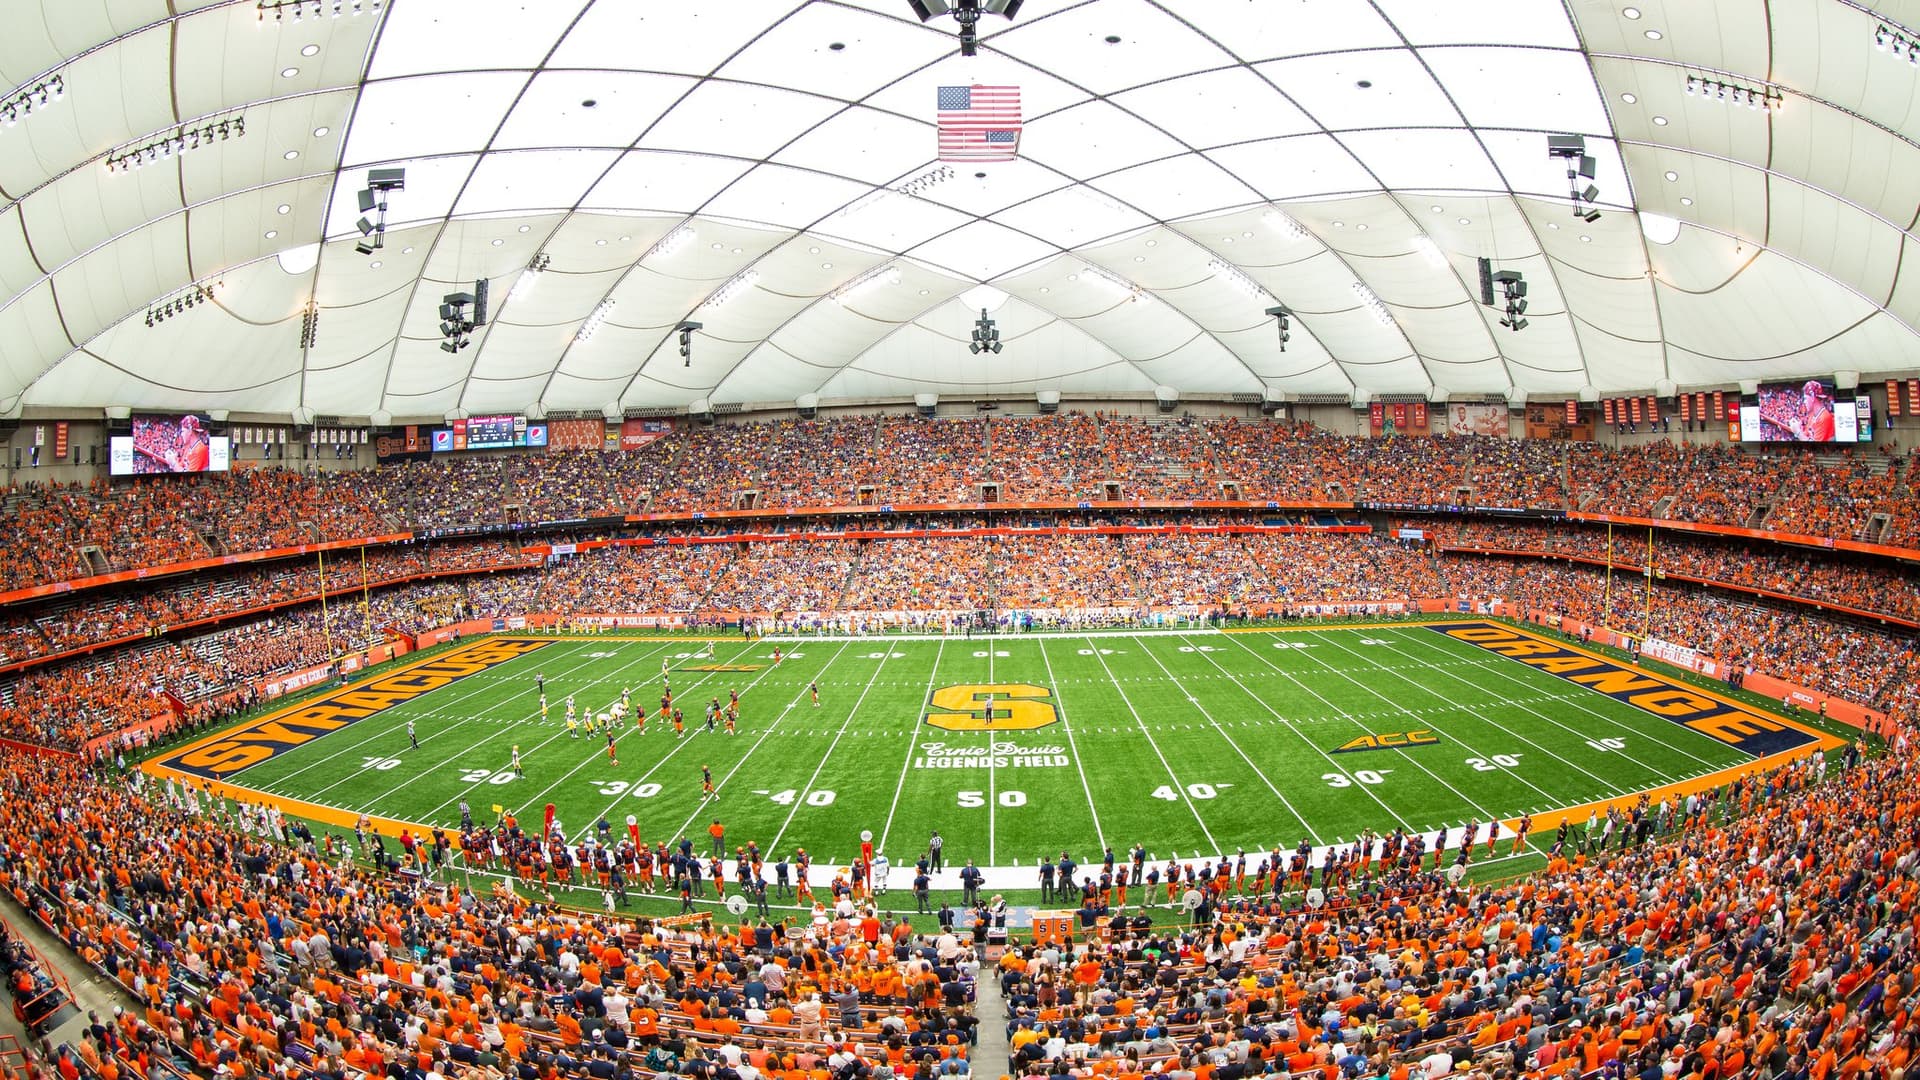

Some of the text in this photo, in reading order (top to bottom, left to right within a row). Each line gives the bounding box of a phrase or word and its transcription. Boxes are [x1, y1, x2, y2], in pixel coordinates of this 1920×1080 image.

[1446, 627, 1787, 743] ORANGE
[180, 639, 548, 773] SYRACUSE
[924, 684, 1060, 731] S
[920, 740, 1065, 757] Ernie Davis
[1331, 729, 1440, 752] ACC
[1586, 737, 1625, 752] 10
[363, 756, 403, 771] 10
[914, 755, 1070, 769] LEGENDS FIELD
[1464, 753, 1520, 772] 20
[459, 768, 516, 785] 20
[1321, 769, 1386, 789] 30
[598, 781, 663, 798] 30
[768, 789, 837, 806] 40
[1151, 783, 1219, 801] 40
[957, 790, 1028, 808] 50
